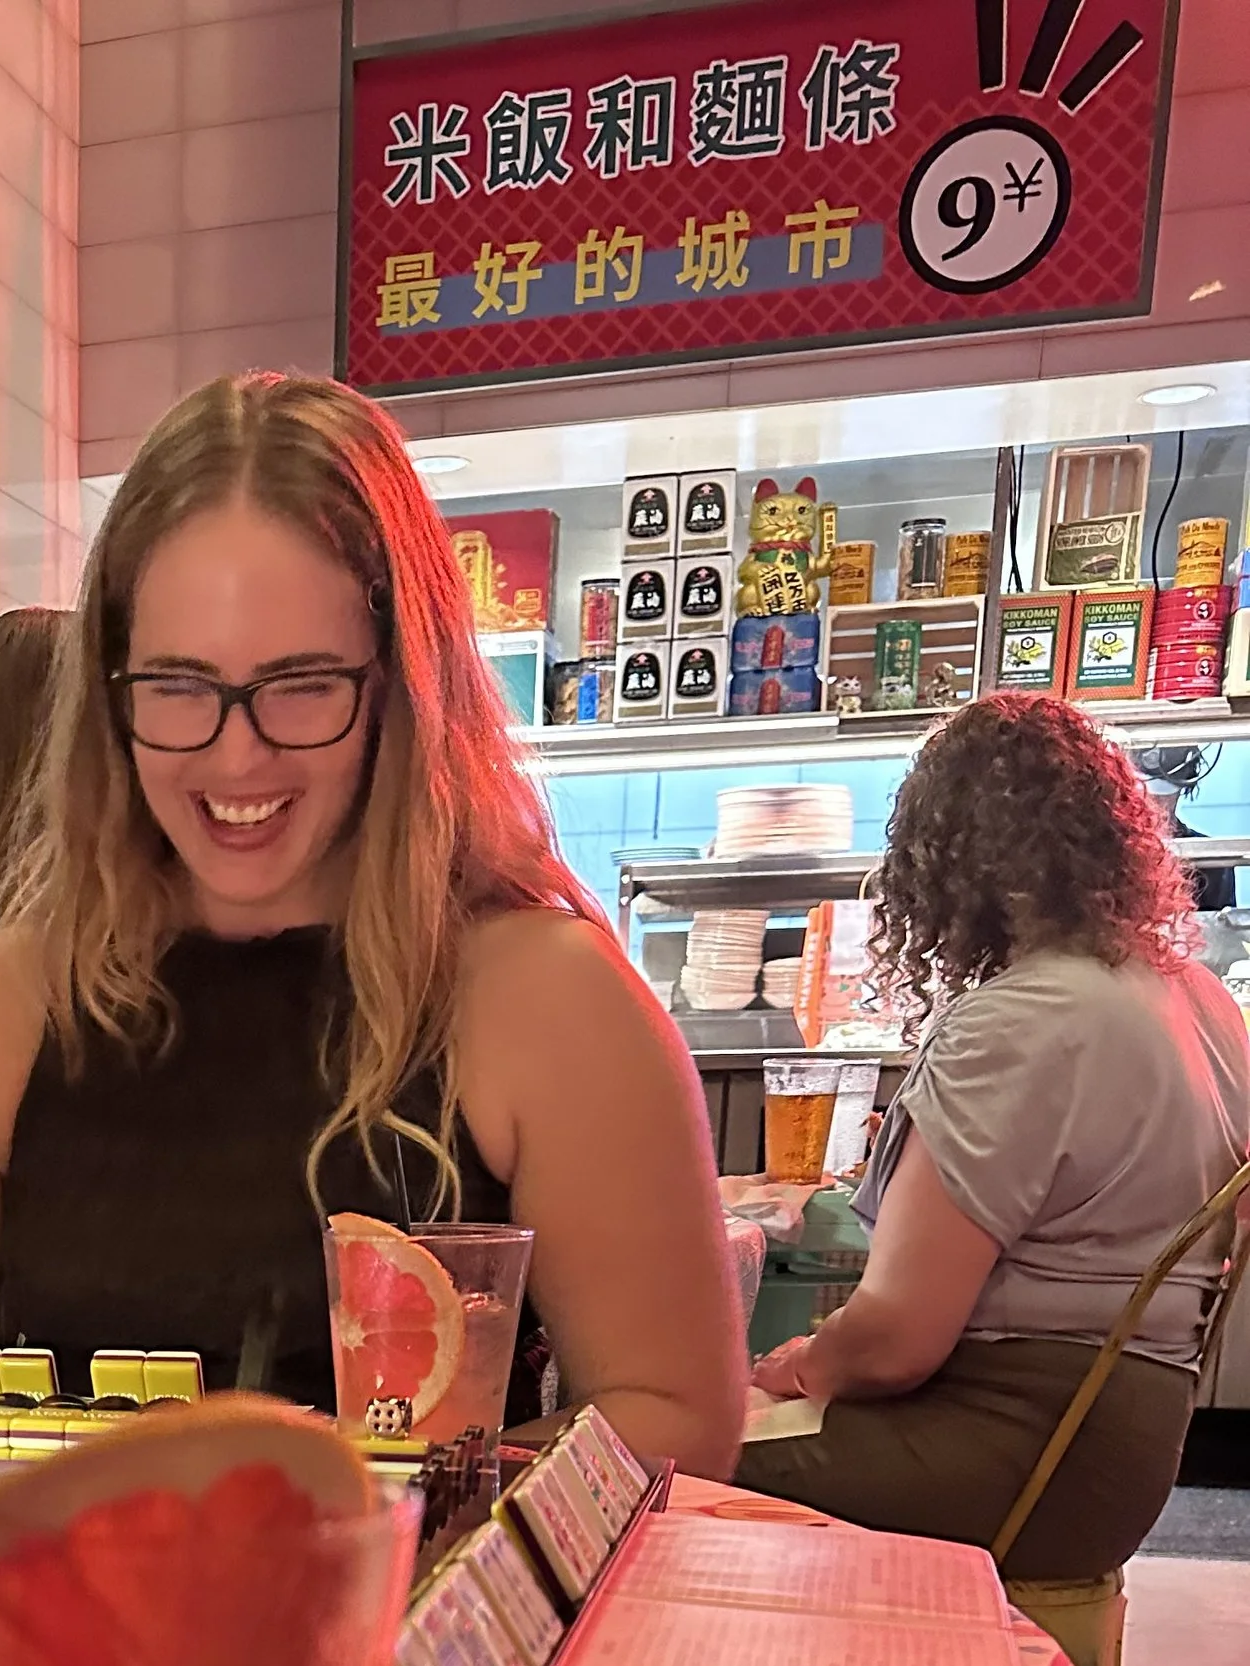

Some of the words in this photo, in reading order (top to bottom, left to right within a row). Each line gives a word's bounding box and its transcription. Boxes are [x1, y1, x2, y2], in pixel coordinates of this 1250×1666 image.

[383, 41, 901, 207] 米飯和麵條
[376, 199, 860, 329] 最好的城市
[1003, 608, 1058, 620] KIKKOMAN
[1084, 603, 1140, 615] KIKKOMAN
[1003, 620, 1021, 628] SOY
[1024, 618, 1056, 627] SAUCE
[1084, 615, 1104, 623] SOY
[1107, 613, 1139, 621] SAUCE
